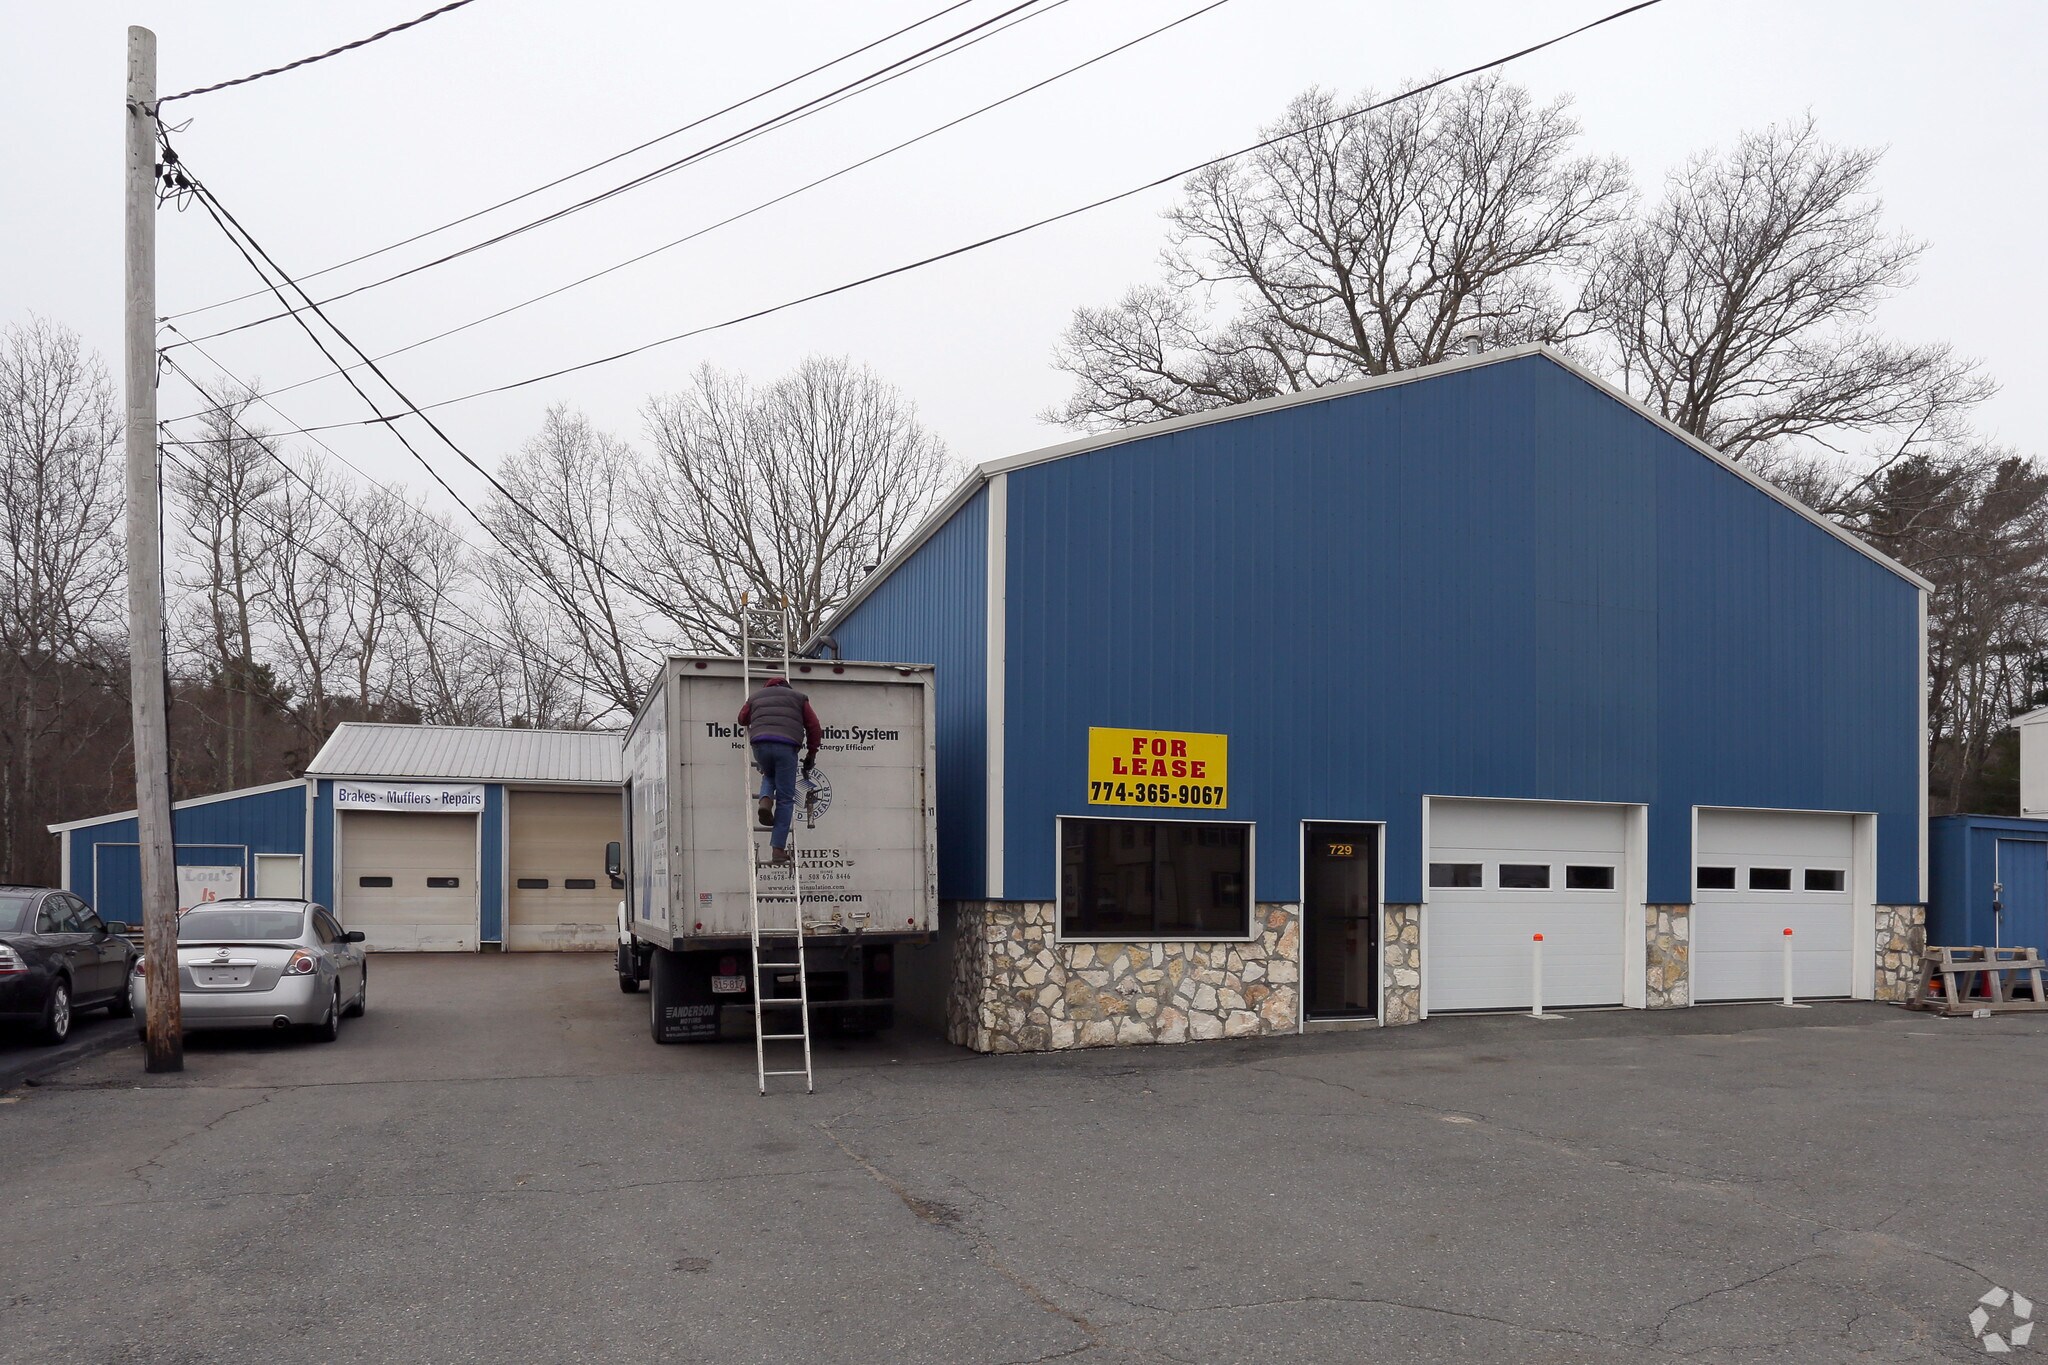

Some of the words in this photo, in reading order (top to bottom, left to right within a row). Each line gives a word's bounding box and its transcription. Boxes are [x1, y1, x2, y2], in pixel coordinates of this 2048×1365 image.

[706, 722, 731, 738] The
[852, 726, 899, 743] System
[819, 744, 844, 752] Energy
[1132, 737, 1187, 757] FOR
[1112, 757, 1206, 778] LEASE
[338, 788, 376, 803] Brakes
[386, 790, 431, 804] Mufflers
[442, 791, 481, 807] Repairs
[1091, 781, 1224, 805] 774-365-9067
[1329, 845, 1353, 855] 729
[184, 869, 234, 882] Lou's
[202, 888, 216, 902] Is
[672, 1005, 716, 1018] ANDERSON
